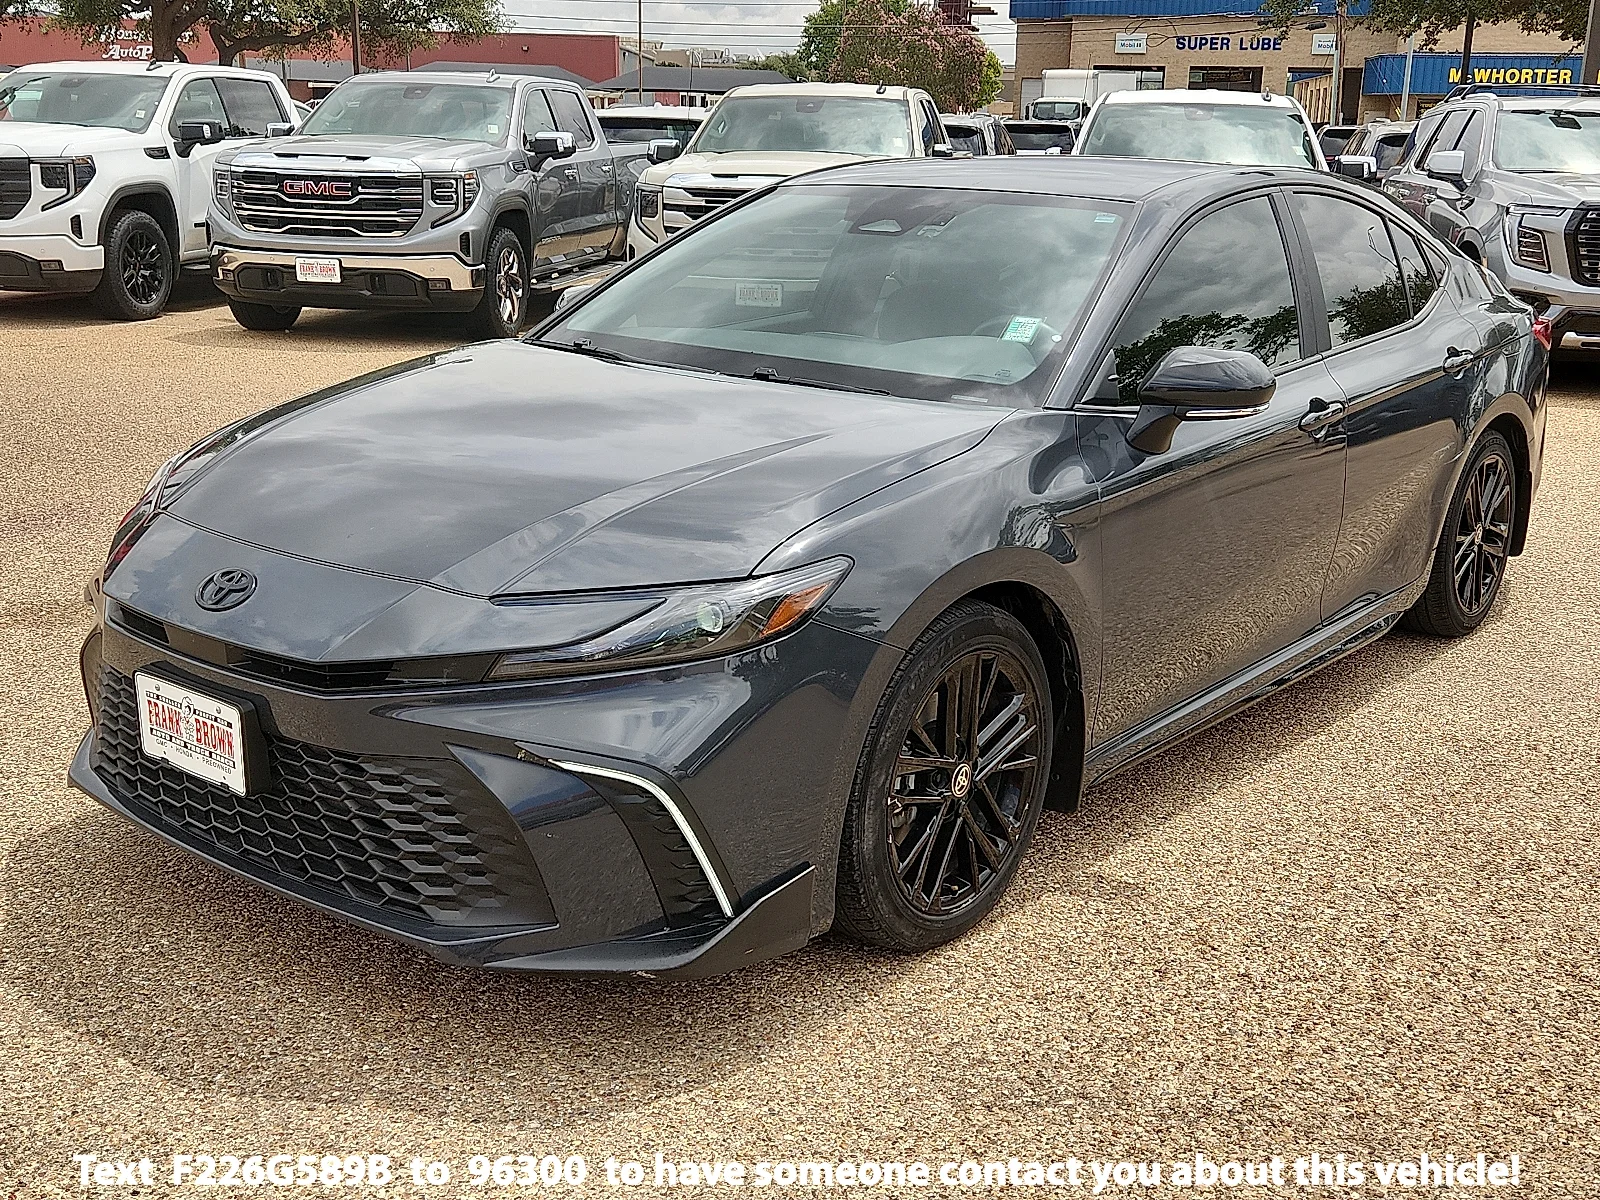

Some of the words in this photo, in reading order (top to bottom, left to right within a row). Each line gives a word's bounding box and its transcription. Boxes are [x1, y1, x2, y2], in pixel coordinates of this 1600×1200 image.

[1176, 36, 1230, 50] SUPER
[1239, 37, 1282, 50] LUBE
[283, 180, 351, 195] GMC
[147, 700, 183, 738] FRANK
[195, 718, 235, 760] BROWN
[151, 728, 170, 742] AUTO
[171, 735, 185, 748] AND
[155, 738, 168, 749] GMC
[175, 746, 194, 760] HONDA
[201, 756, 232, 775] PREOWNED
